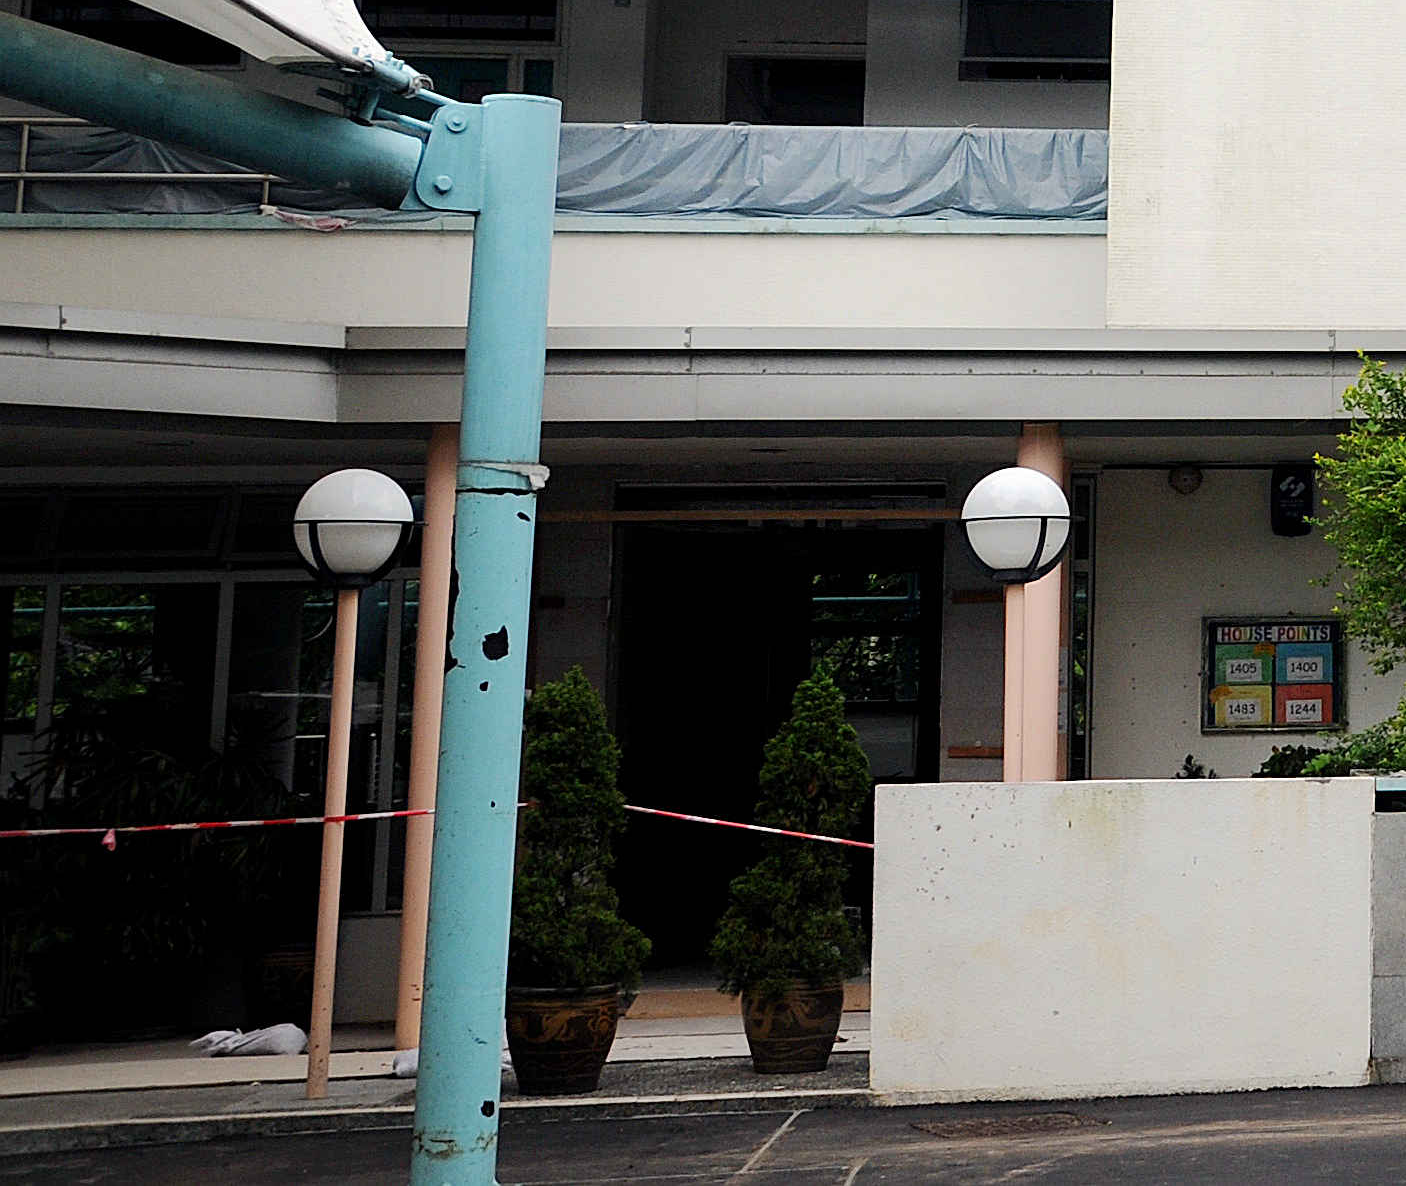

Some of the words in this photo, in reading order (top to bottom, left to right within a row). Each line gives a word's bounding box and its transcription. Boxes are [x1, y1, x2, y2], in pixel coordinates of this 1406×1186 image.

[1222, 626, 1272, 642] HOUSE
[1278, 626, 1329, 642] POINTS
[1230, 662, 1257, 674] 1405
[1290, 661, 1318, 673] 1400
[1290, 703, 1317, 715] 1244
